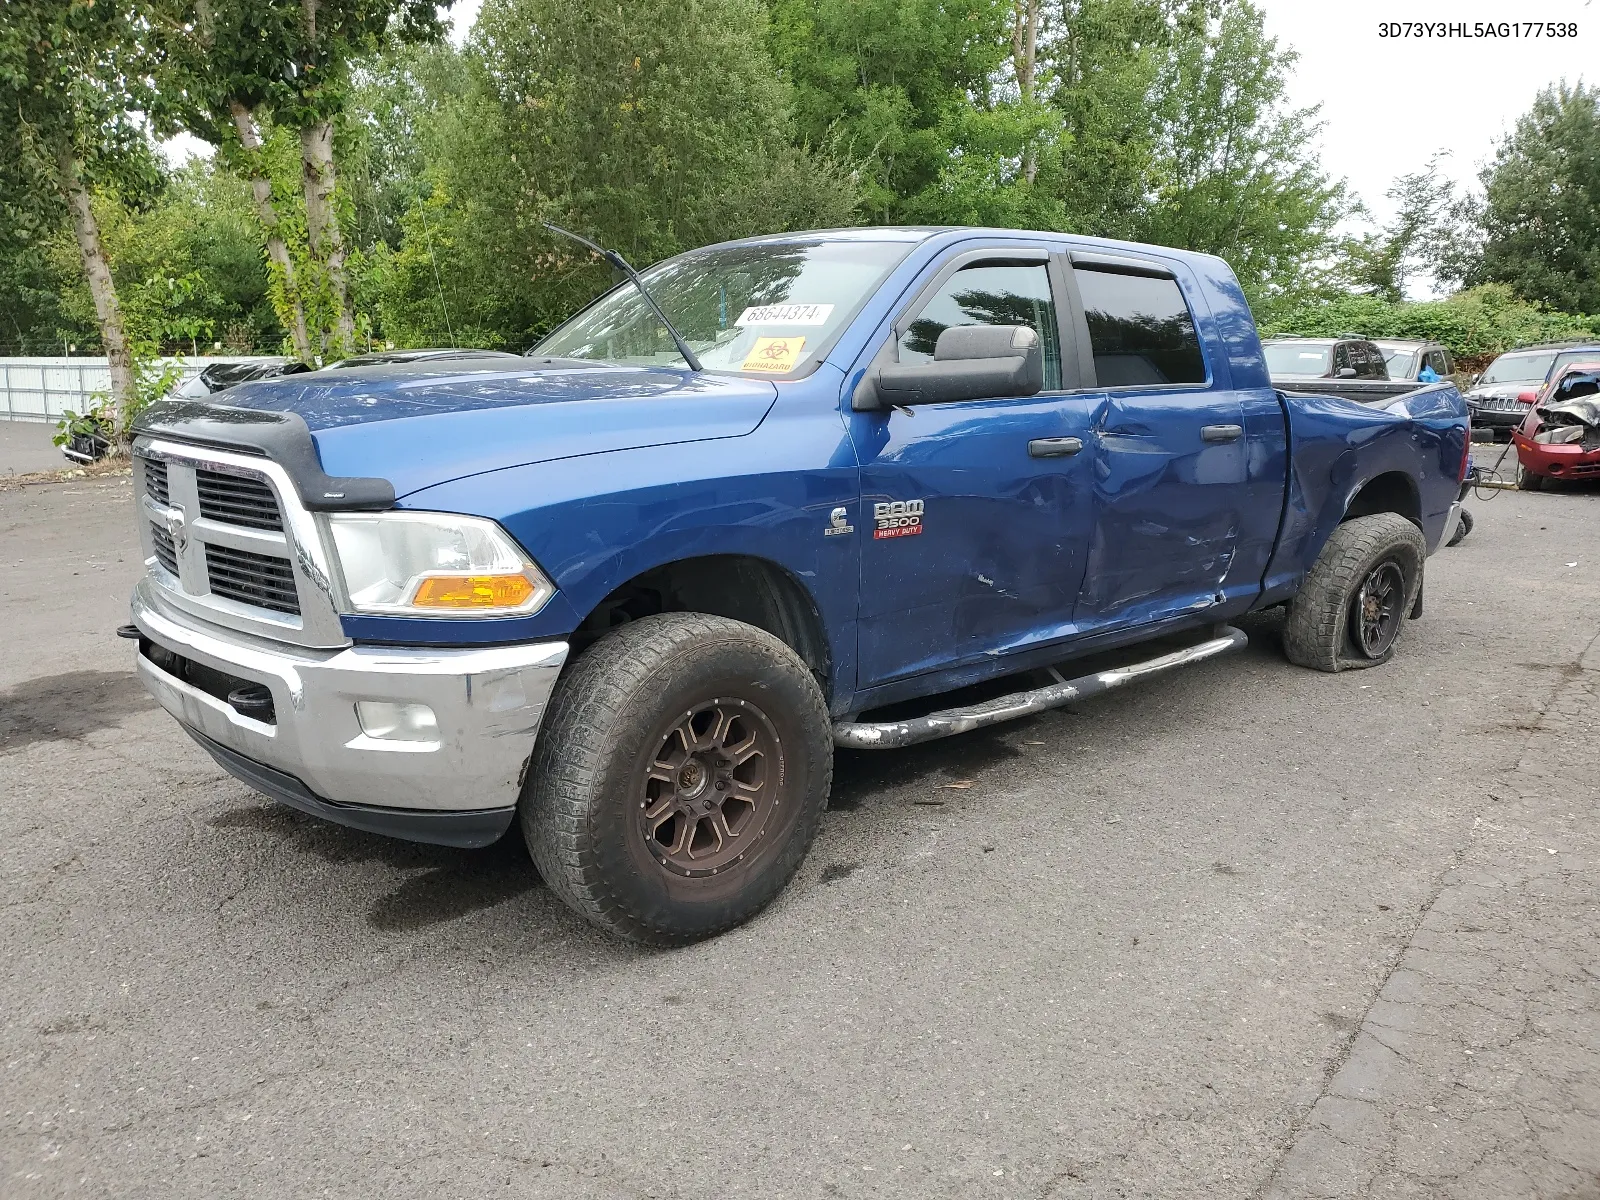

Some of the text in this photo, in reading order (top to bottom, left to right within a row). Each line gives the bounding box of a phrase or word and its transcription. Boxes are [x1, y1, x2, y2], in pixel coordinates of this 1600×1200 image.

[747, 305, 819, 322] 68644374
[743, 362, 791, 370] BIOHAZARD
[874, 499, 924, 519] RAM
[878, 516, 919, 529] 3500
[879, 526, 918, 537] HEAVY DUTY
